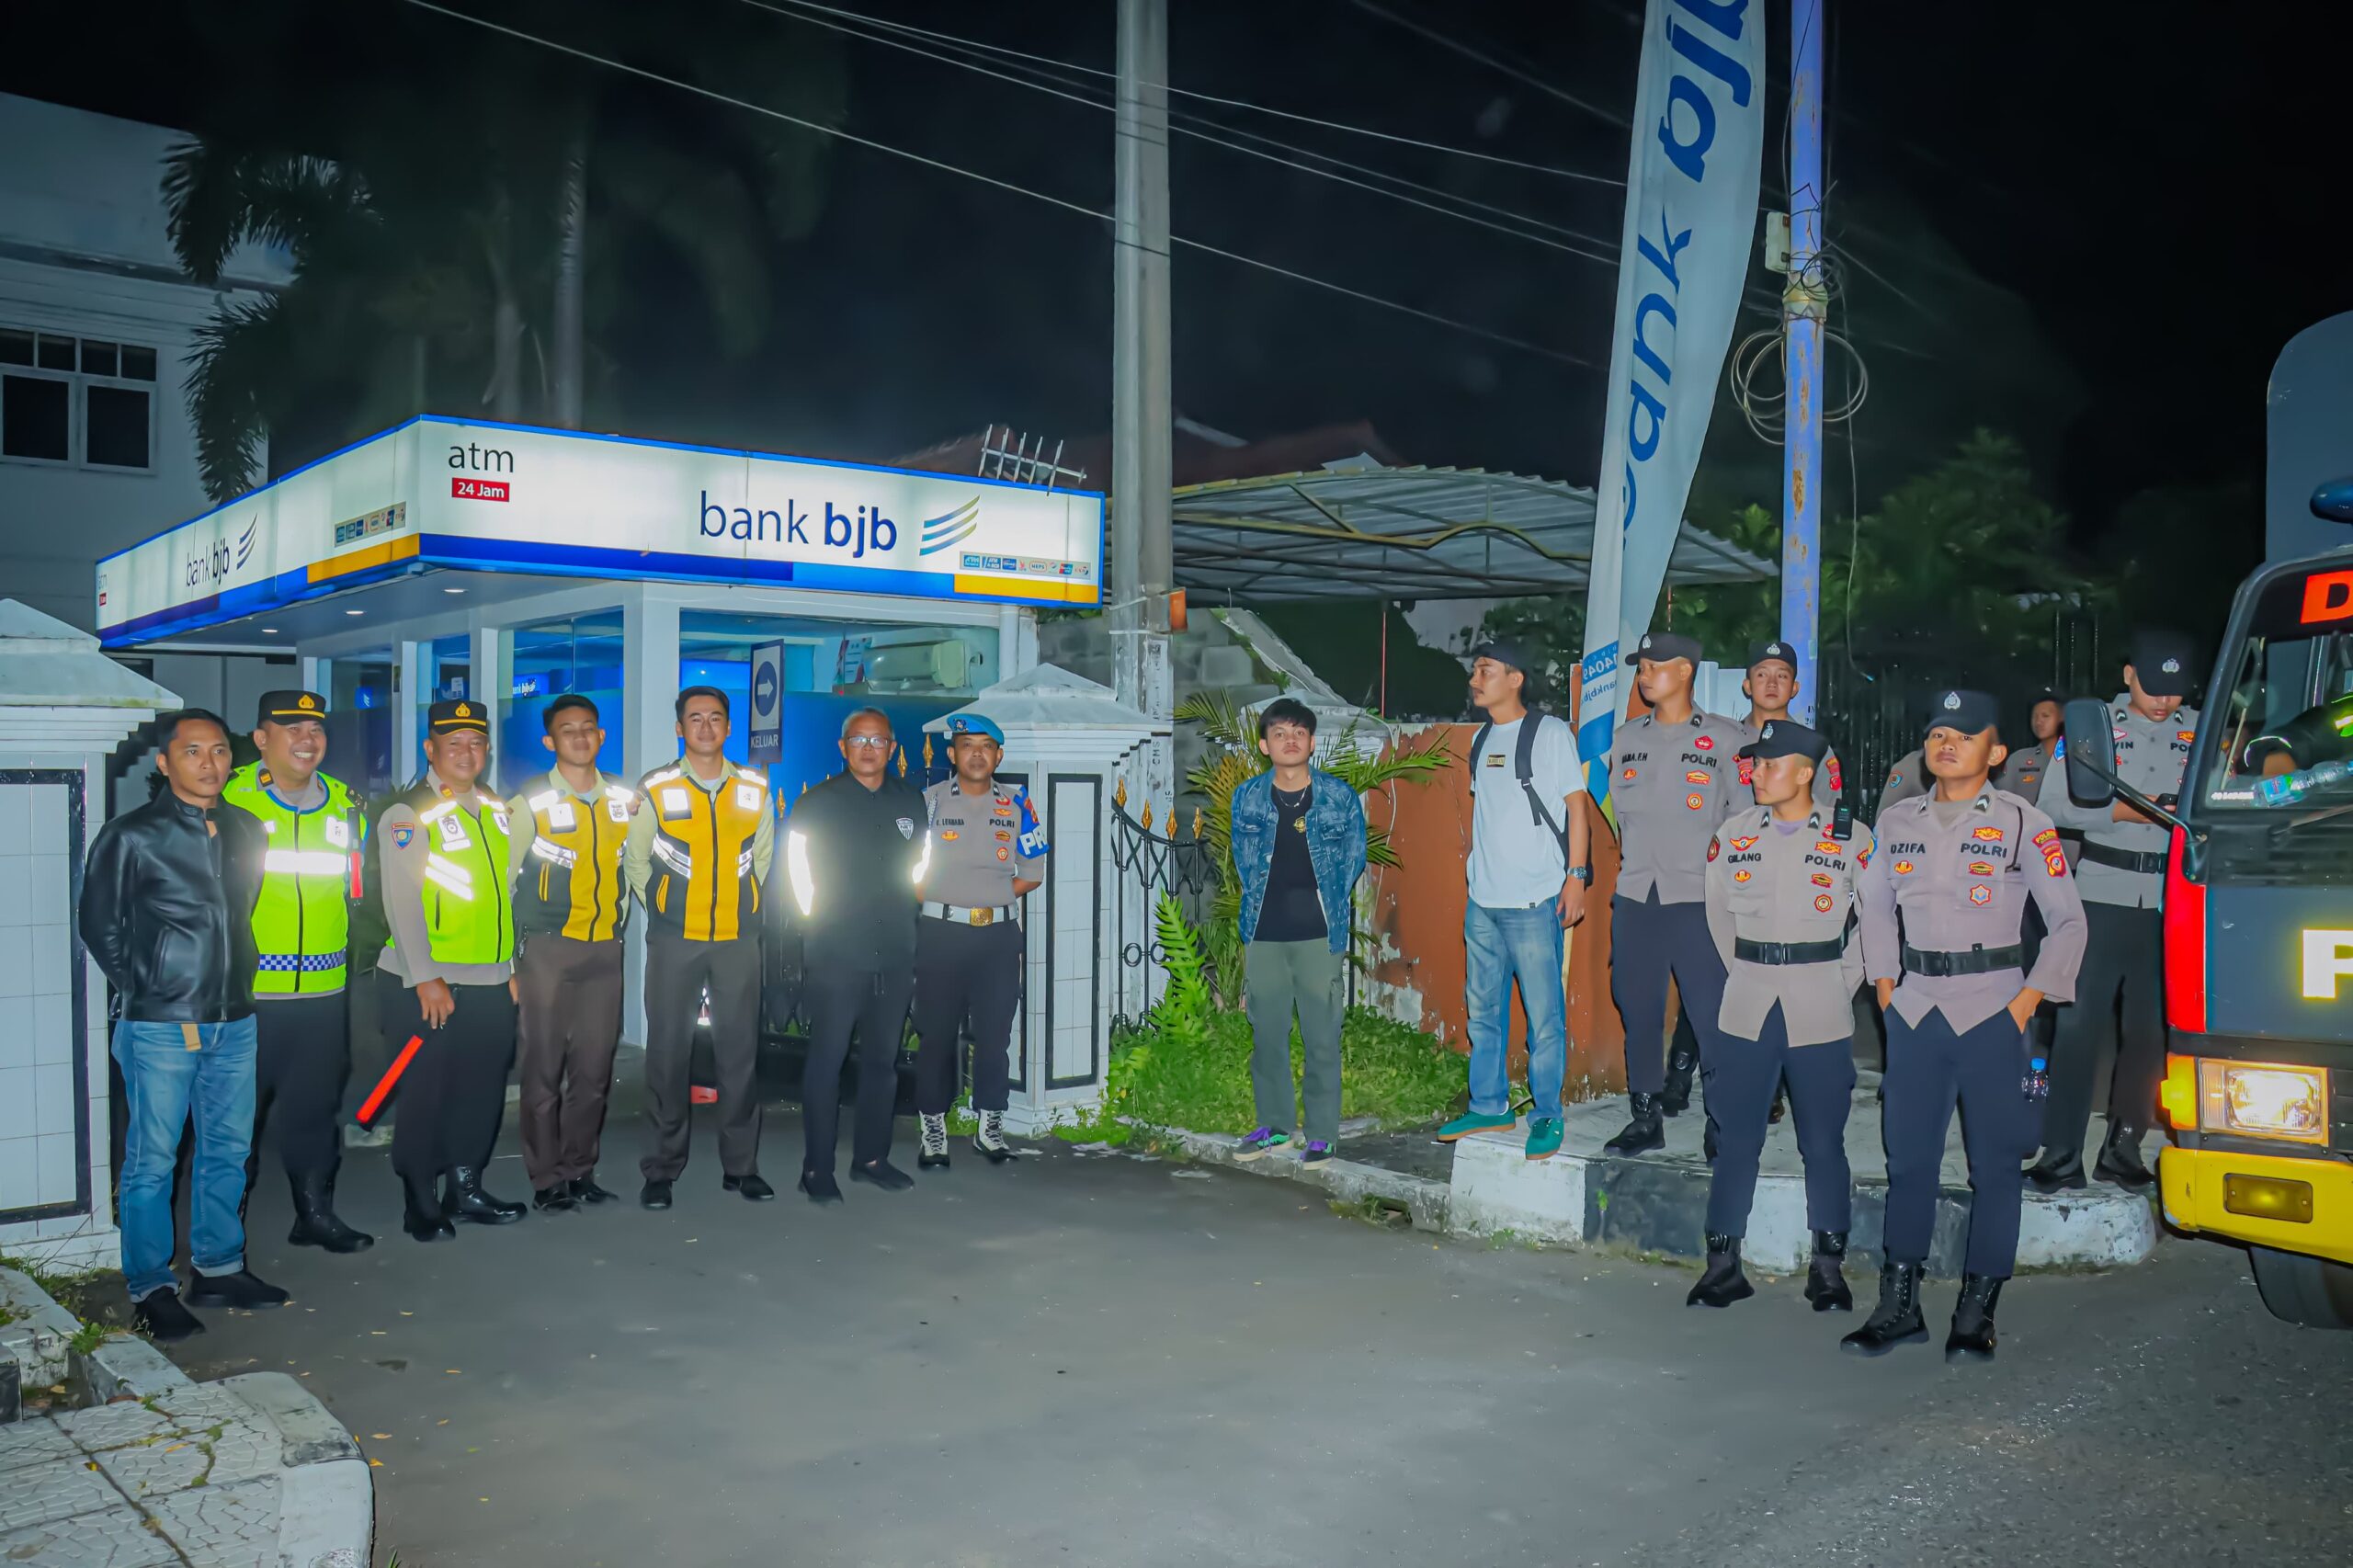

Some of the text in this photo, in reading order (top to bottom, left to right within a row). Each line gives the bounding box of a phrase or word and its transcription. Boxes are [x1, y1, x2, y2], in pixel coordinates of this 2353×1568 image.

[449, 442, 514, 473] atm
[457, 482, 505, 498] 24 Jam
[699, 490, 898, 559] bank bjb
[186, 538, 230, 587] bank bjb
[750, 734, 779, 749] KELUAR
[1681, 753, 1717, 768] POLRI
[989, 818, 1016, 828] POLRI
[1727, 852, 1762, 864] GILANG
[1960, 842, 2007, 858] POLRI
[1804, 854, 1847, 872] POLRI
